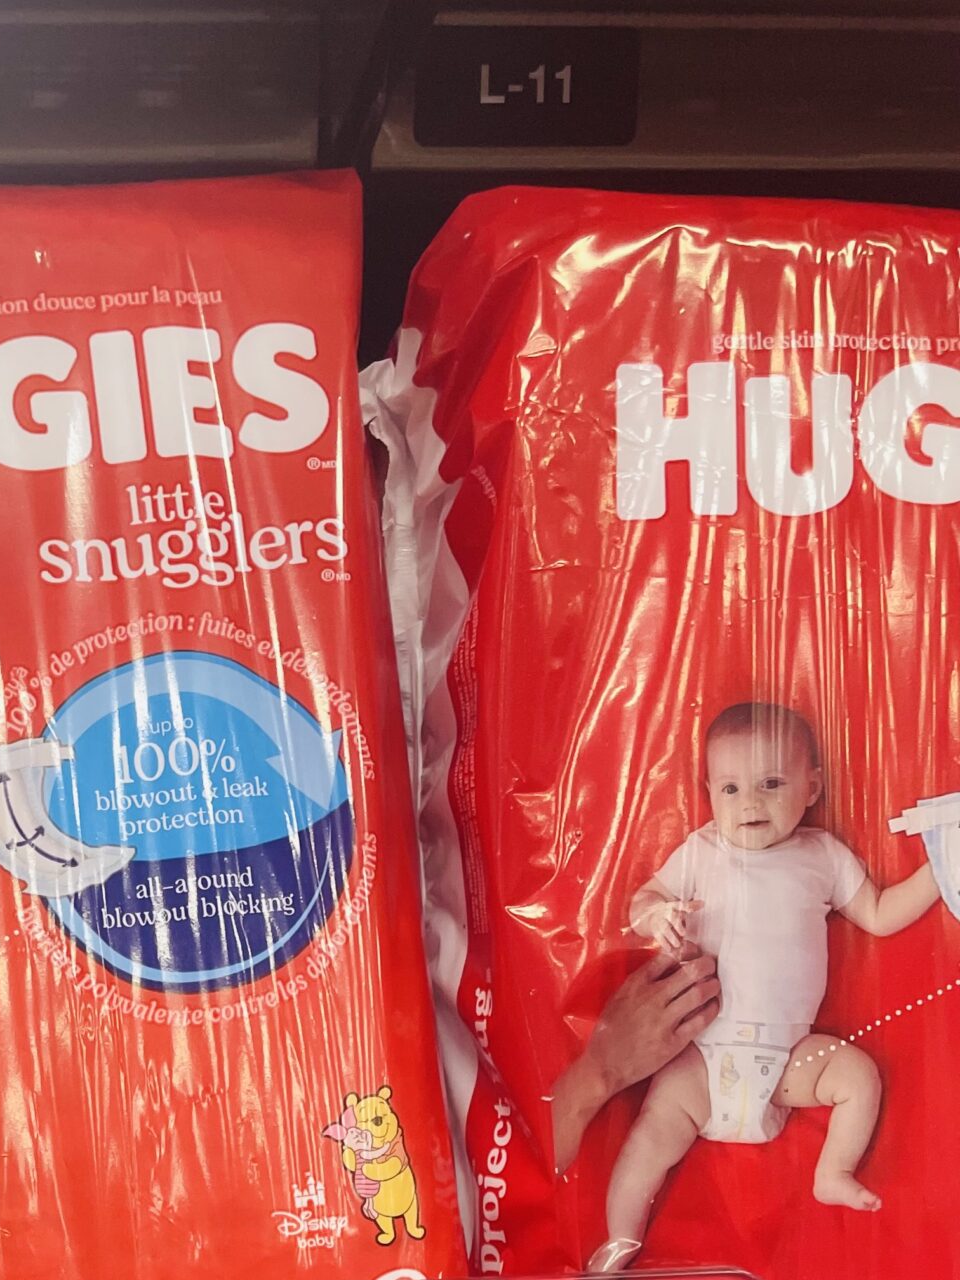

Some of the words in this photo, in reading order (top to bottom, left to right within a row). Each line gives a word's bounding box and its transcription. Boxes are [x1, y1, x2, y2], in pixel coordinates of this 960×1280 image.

[480, 64, 572, 104] L-11
[33, 292, 96, 312] douce
[100, 288, 149, 312] pour
[152, 285, 170, 304] la
[175, 289, 223, 306] peau
[616, 361, 960, 520] HUG
[126, 483, 226, 526] little
[39, 512, 348, 589] snugglers
[51, 650, 75, 676] de
[74, 611, 184, 659] protection
[199, 611, 256, 648] fuites
[118, 737, 236, 783] 100%
[95, 782, 197, 811] blowout
[223, 776, 269, 798] leak
[202, 893, 295, 918] blocking
[210, 993, 276, 1022] contre
[277, 974, 308, 1002] les
[477, 1097, 513, 1276] project
[271, 1211, 348, 1236] Disney
[297, 1234, 335, 1249] baby
